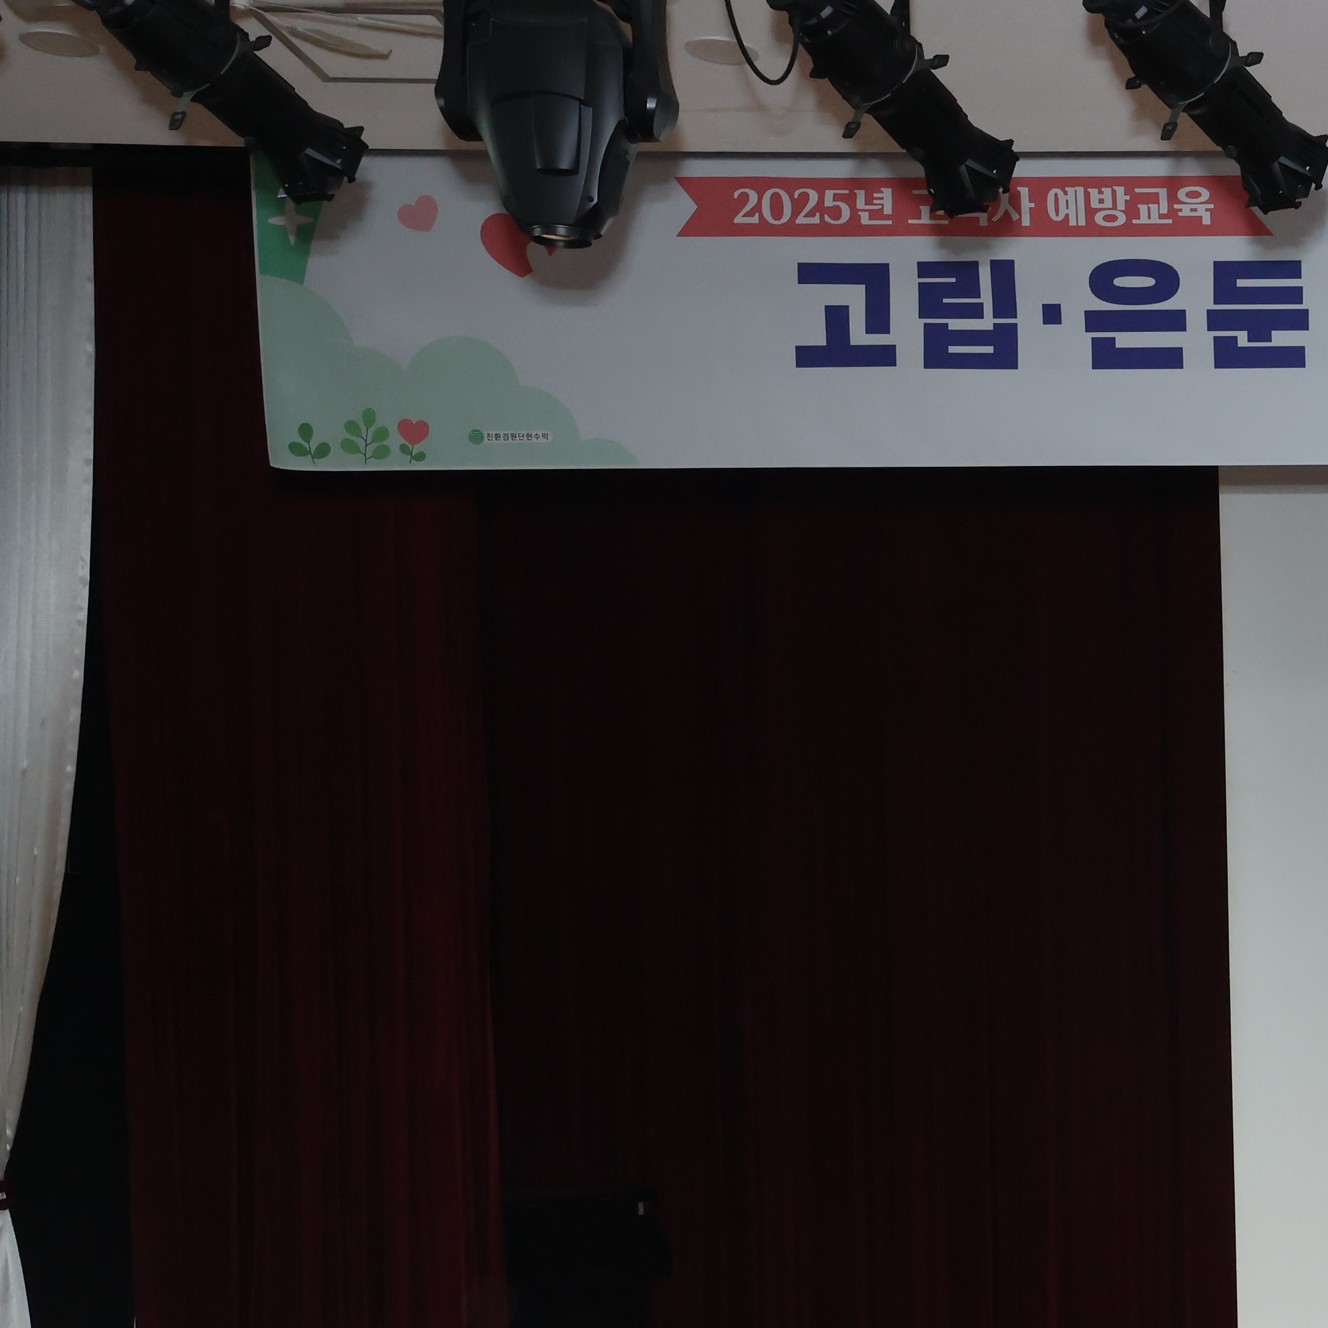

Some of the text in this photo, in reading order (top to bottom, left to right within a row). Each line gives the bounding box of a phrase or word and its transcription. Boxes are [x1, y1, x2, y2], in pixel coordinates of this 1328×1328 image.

[732, 186, 894, 226] 2025년
[1046, 185, 1215, 227] 예방교육
[795, 258, 1310, 370] 고립·은둔
